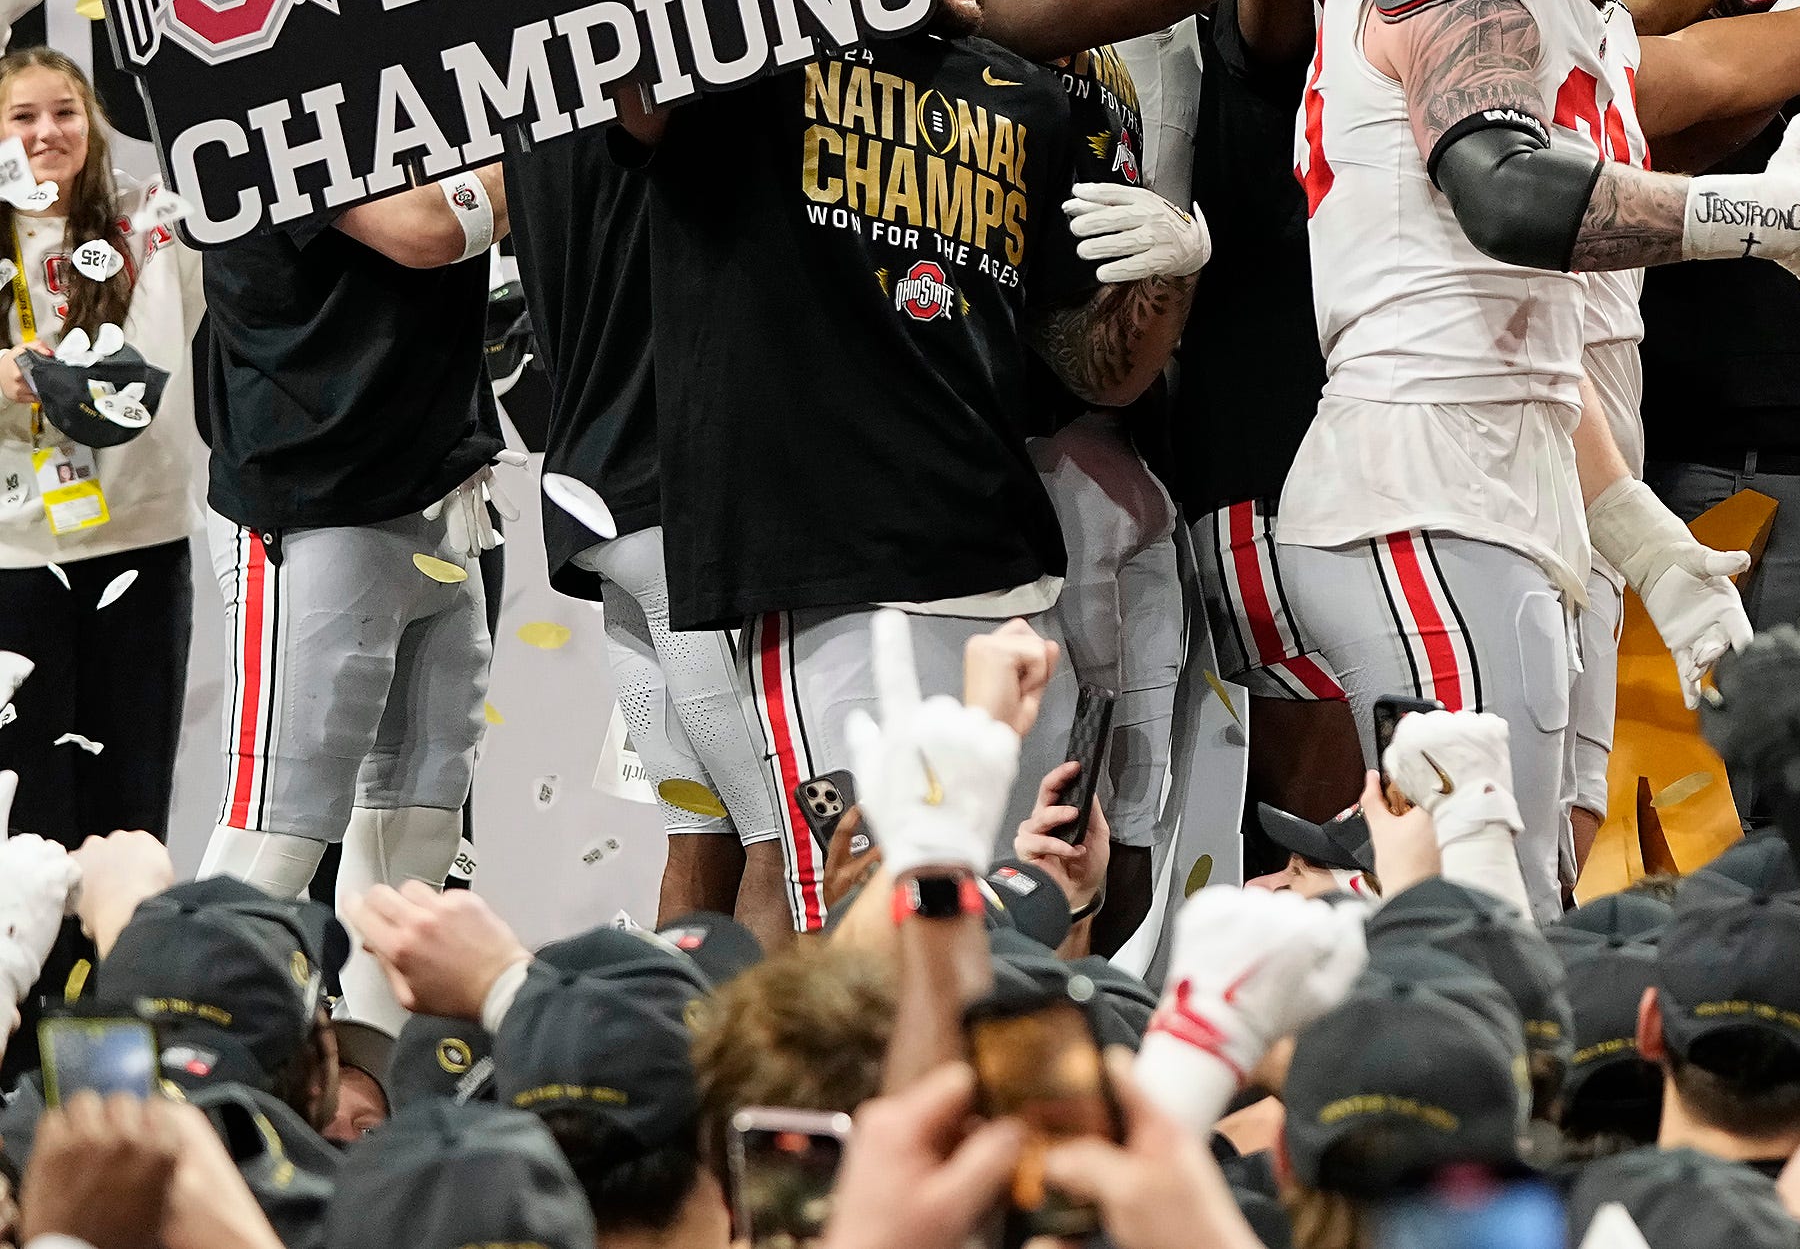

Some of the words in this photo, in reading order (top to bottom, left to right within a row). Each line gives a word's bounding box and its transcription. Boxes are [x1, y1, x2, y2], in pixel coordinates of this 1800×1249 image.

[804, 60, 1028, 194] NATIONAL
[802, 123, 1028, 269] CHAMPS
[806, 204, 862, 235] WON
[872, 222, 919, 250] FOR
[933, 232, 970, 266] THE
[979, 254, 1020, 289] AGES
